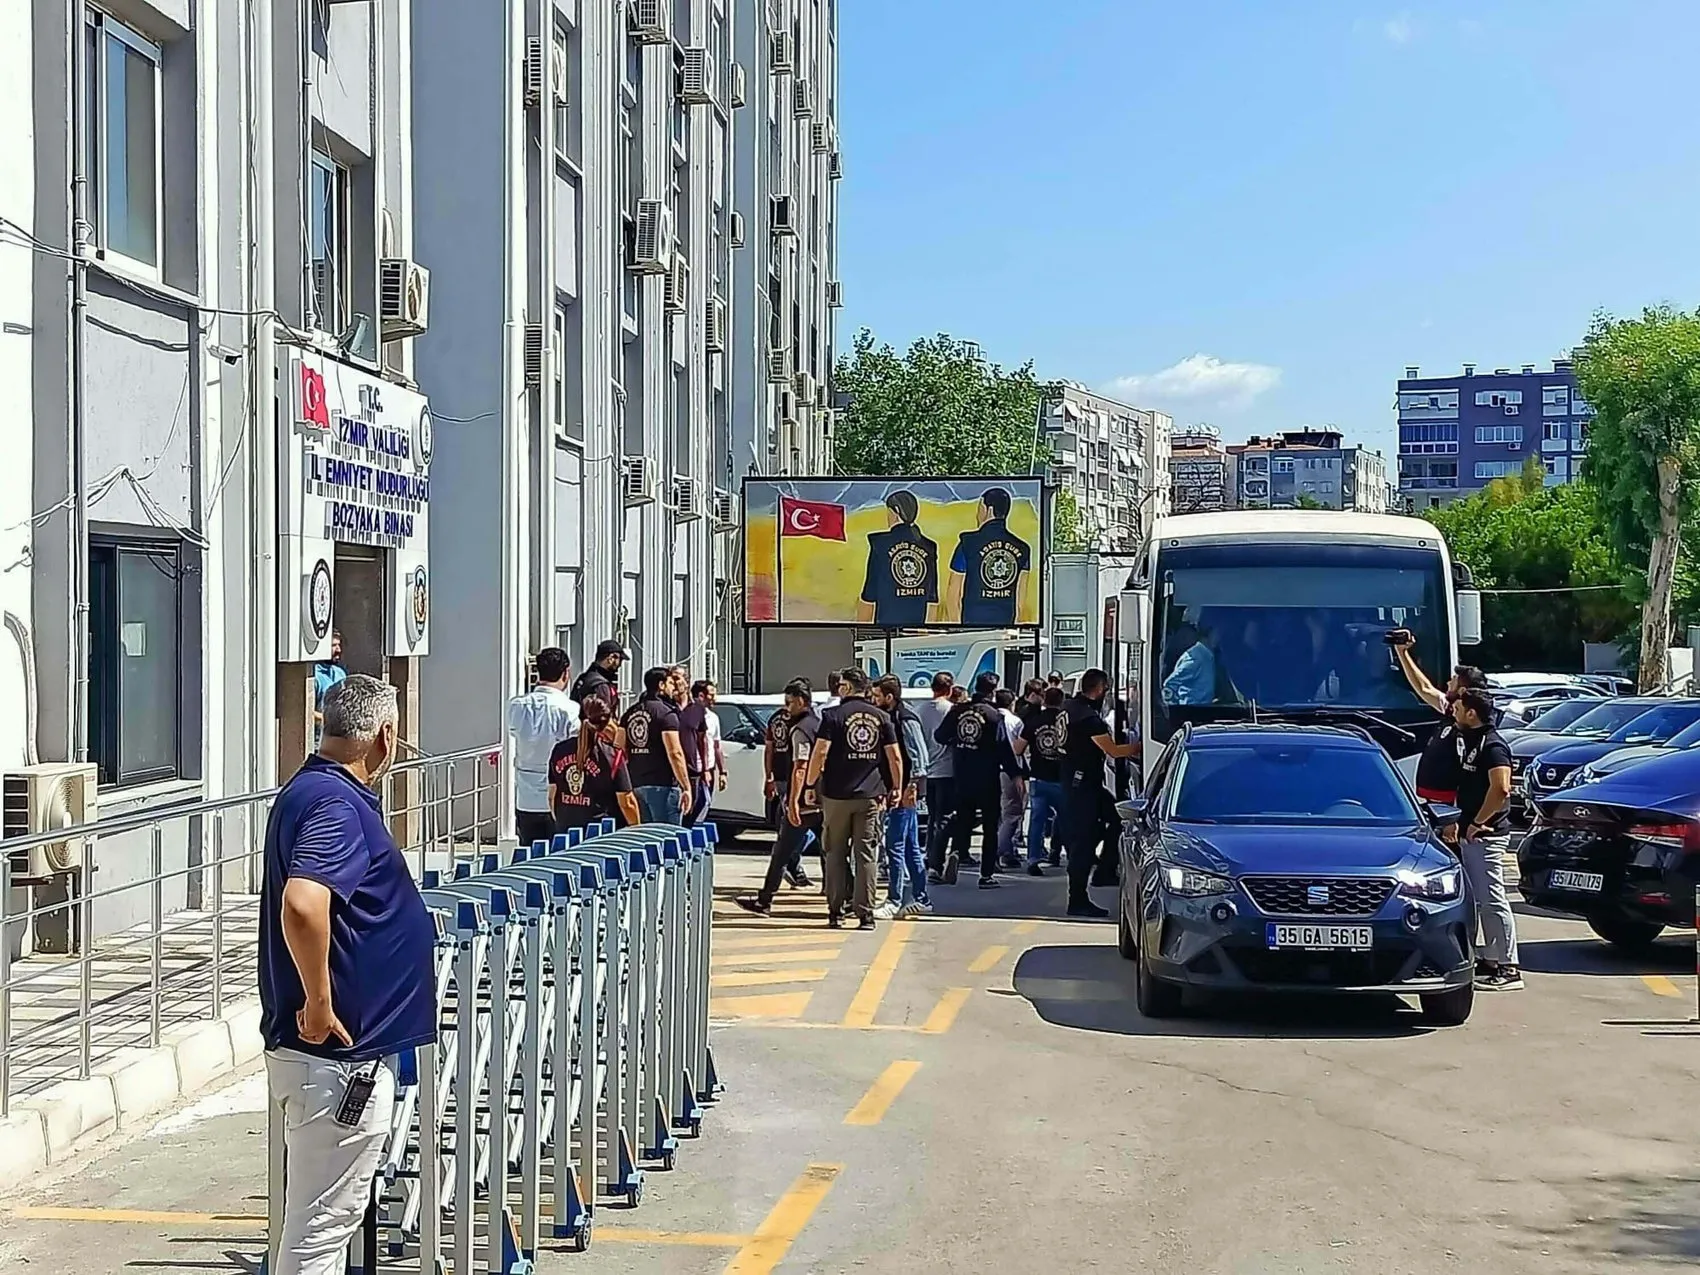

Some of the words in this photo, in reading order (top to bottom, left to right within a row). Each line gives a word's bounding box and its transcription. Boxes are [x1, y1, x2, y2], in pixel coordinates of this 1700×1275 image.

[333, 501, 380, 532] BOZYAKA
[1553, 871, 1565, 885] 35
[1278, 927, 1297, 944] 35
[1303, 927, 1322, 944] GA
[1330, 928, 1369, 945] 5615
